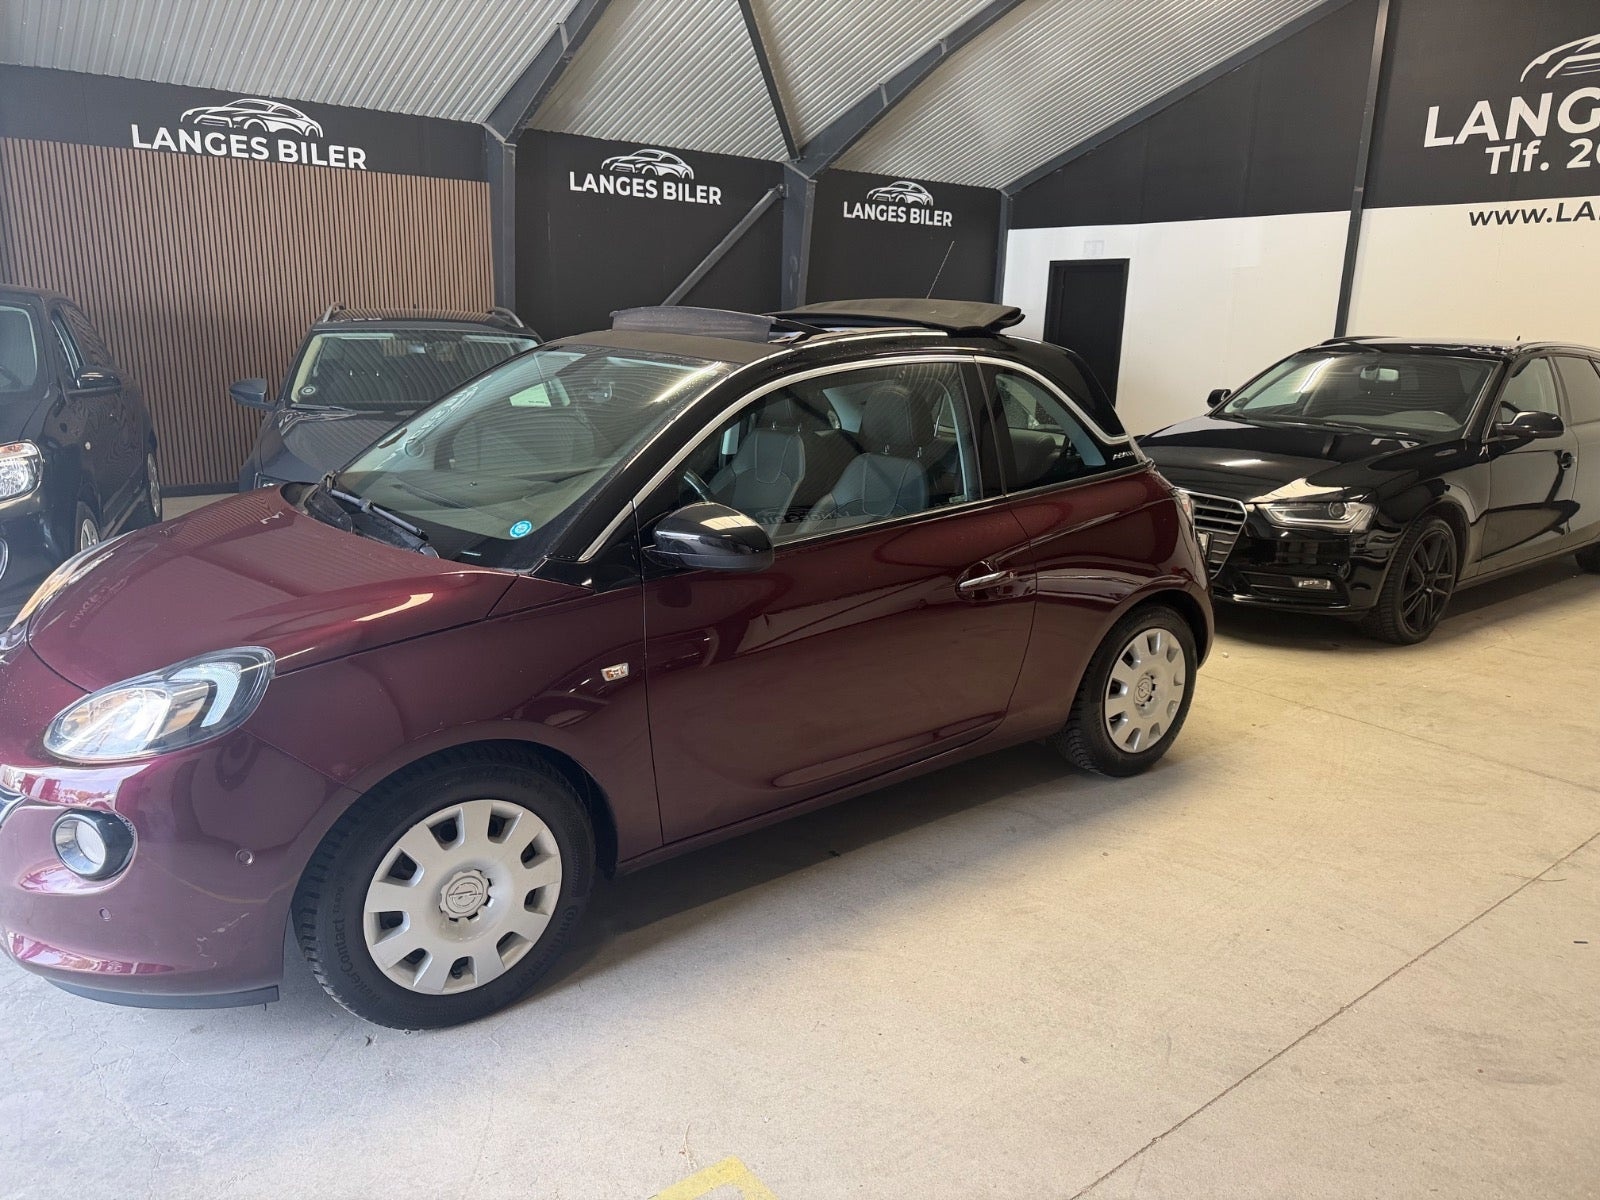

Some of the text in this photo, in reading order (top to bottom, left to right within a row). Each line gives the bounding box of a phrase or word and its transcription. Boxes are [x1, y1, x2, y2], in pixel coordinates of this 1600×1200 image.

[131, 123, 367, 170] LANGES BILER
[1484, 137, 1600, 175] Tlf. 2
[569, 171, 722, 206] LANGES BILER
[843, 201, 953, 227] LANGES BILER
[1469, 201, 1600, 227] www.LA
